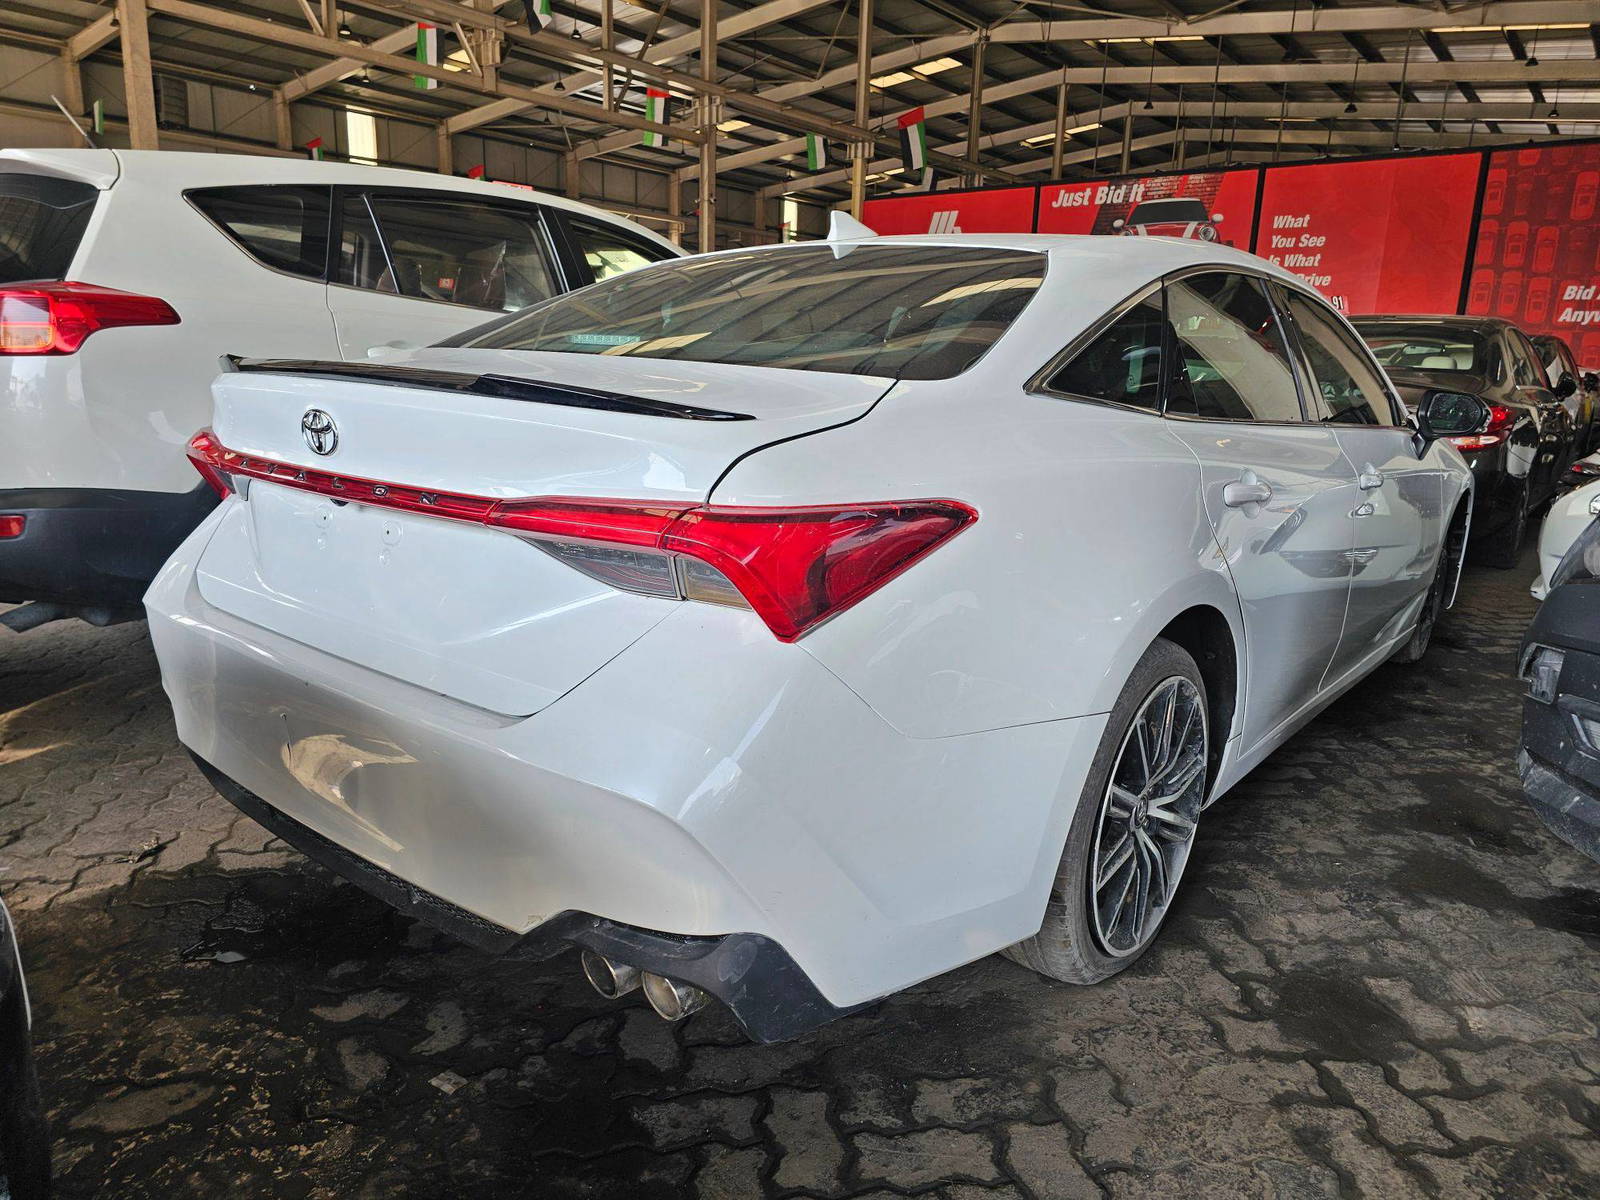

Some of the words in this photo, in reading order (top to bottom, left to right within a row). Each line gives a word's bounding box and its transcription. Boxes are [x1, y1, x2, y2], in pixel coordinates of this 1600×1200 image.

[1052, 189, 1091, 207] Just
[1095, 184, 1127, 204] Bid
[1130, 184, 1145, 202] It
[1273, 214, 1310, 229] What
[1271, 235, 1296, 248] You
[1299, 234, 1326, 247] See
[1284, 254, 1321, 267] What
[1562, 285, 1596, 300] Bid
